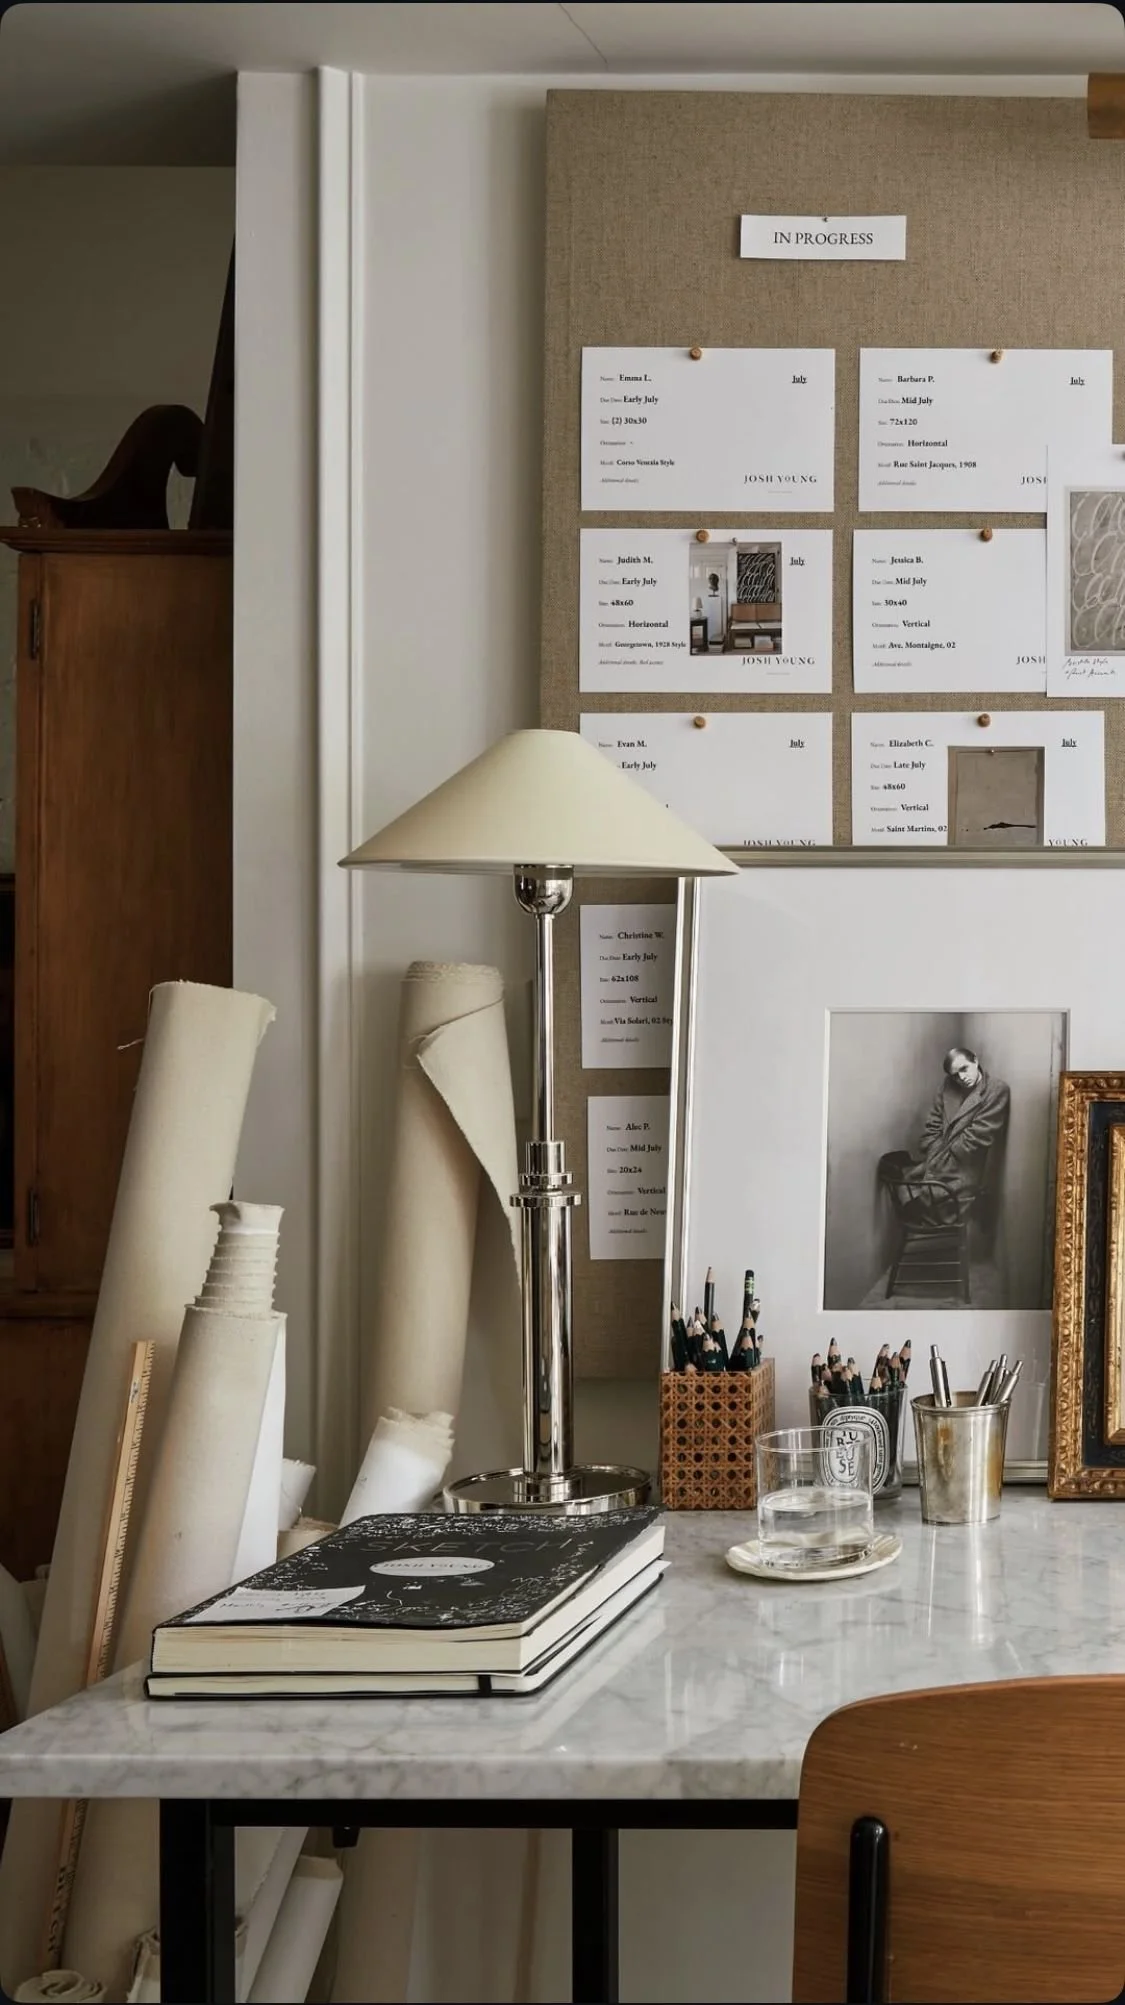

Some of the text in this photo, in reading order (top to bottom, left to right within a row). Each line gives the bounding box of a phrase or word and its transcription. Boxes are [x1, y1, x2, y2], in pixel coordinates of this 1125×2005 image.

[774, 232, 873, 245] IN PROGRESS
[644, 374, 652, 382] L.
[792, 375, 807, 384] July
[897, 375, 926, 383] Barbara
[928, 375, 935, 383] P.
[1069, 376, 1085, 386] July
[624, 396, 642, 405] Early
[643, 396, 658, 405] July
[917, 396, 934, 406] July
[612, 417, 622, 425] (2)
[624, 417, 647, 425] 30x30
[660, 459, 675, 467] Style
[928, 460, 957, 470] Jacques,
[744, 475, 773, 484] JOSH
[617, 556, 641, 565] Judith
[643, 556, 654, 564] M.
[890, 556, 914, 565] Jessica
[916, 556, 924, 564] B.
[622, 578, 641, 587] Early
[642, 578, 657, 587] July
[896, 577, 911, 585] Mid
[912, 577, 927, 587] July
[628, 620, 668, 628] Horizontal
[672, 641, 686, 649] Style
[742, 656, 771, 665] JOSH
[617, 740, 635, 748] Evan
[636, 740, 647, 748] M.
[790, 739, 805, 748] July
[1062, 738, 1077, 747] July
[622, 761, 657, 771] Early July
[894, 761, 909, 769] Late
[911, 761, 926, 770] July
[907, 825, 937, 833] Martins,
[618, 932, 653, 940] Christine
[654, 932, 664, 940] W.
[622, 953, 641, 963] Early
[642, 953, 658, 963] July
[625, 1123, 641, 1131] Alec
[643, 1123, 651, 1131] P.
[630, 1144, 646, 1152] Mid
[646, 1144, 662, 1154] July
[637, 1187, 666, 1195] Vertical
[361, 1538, 572, 1553] SKETCH
